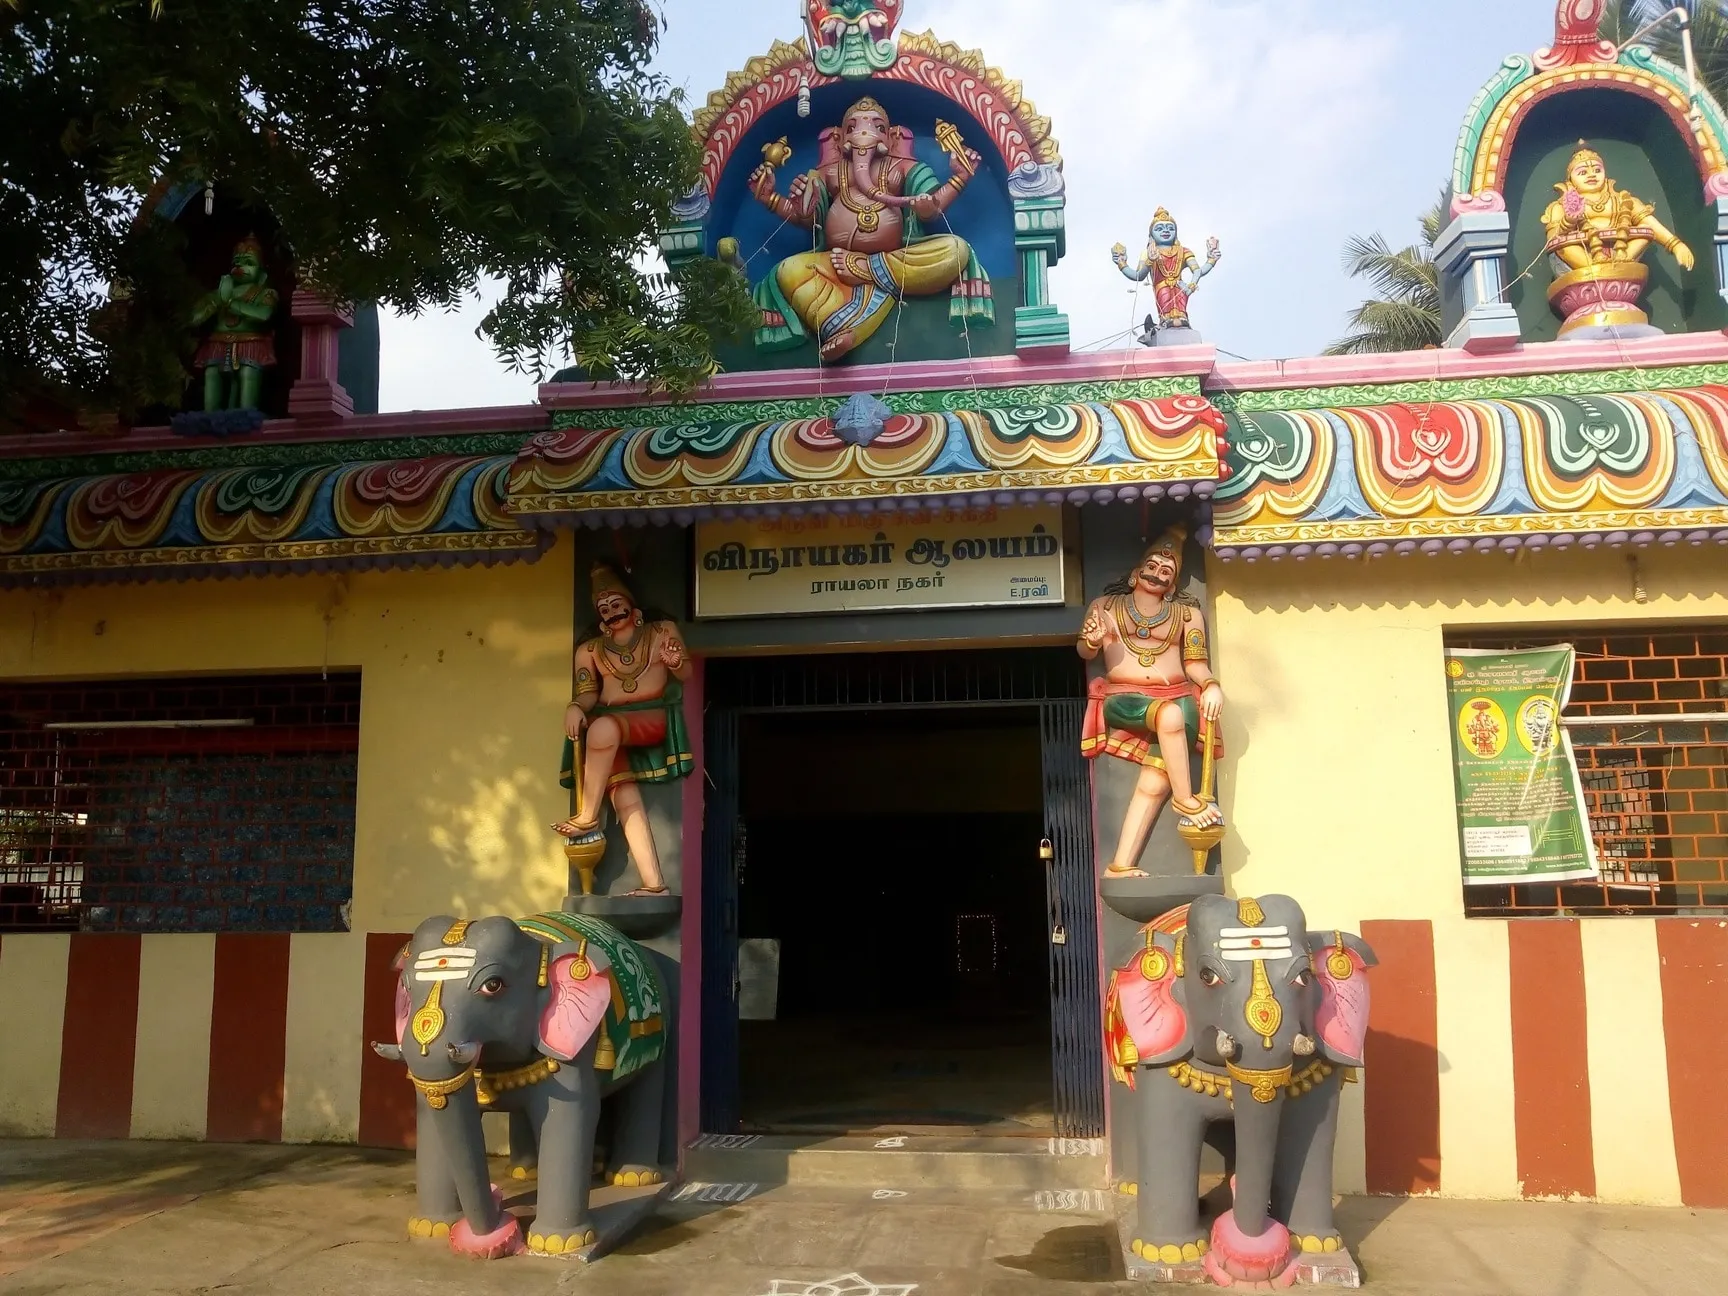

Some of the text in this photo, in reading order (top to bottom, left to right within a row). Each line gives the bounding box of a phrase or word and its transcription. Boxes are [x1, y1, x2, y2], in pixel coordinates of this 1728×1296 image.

[703, 523, 1058, 581] விநாயகர் ஆலயம்
[811, 571, 945, 594] ராயலா நகர்
